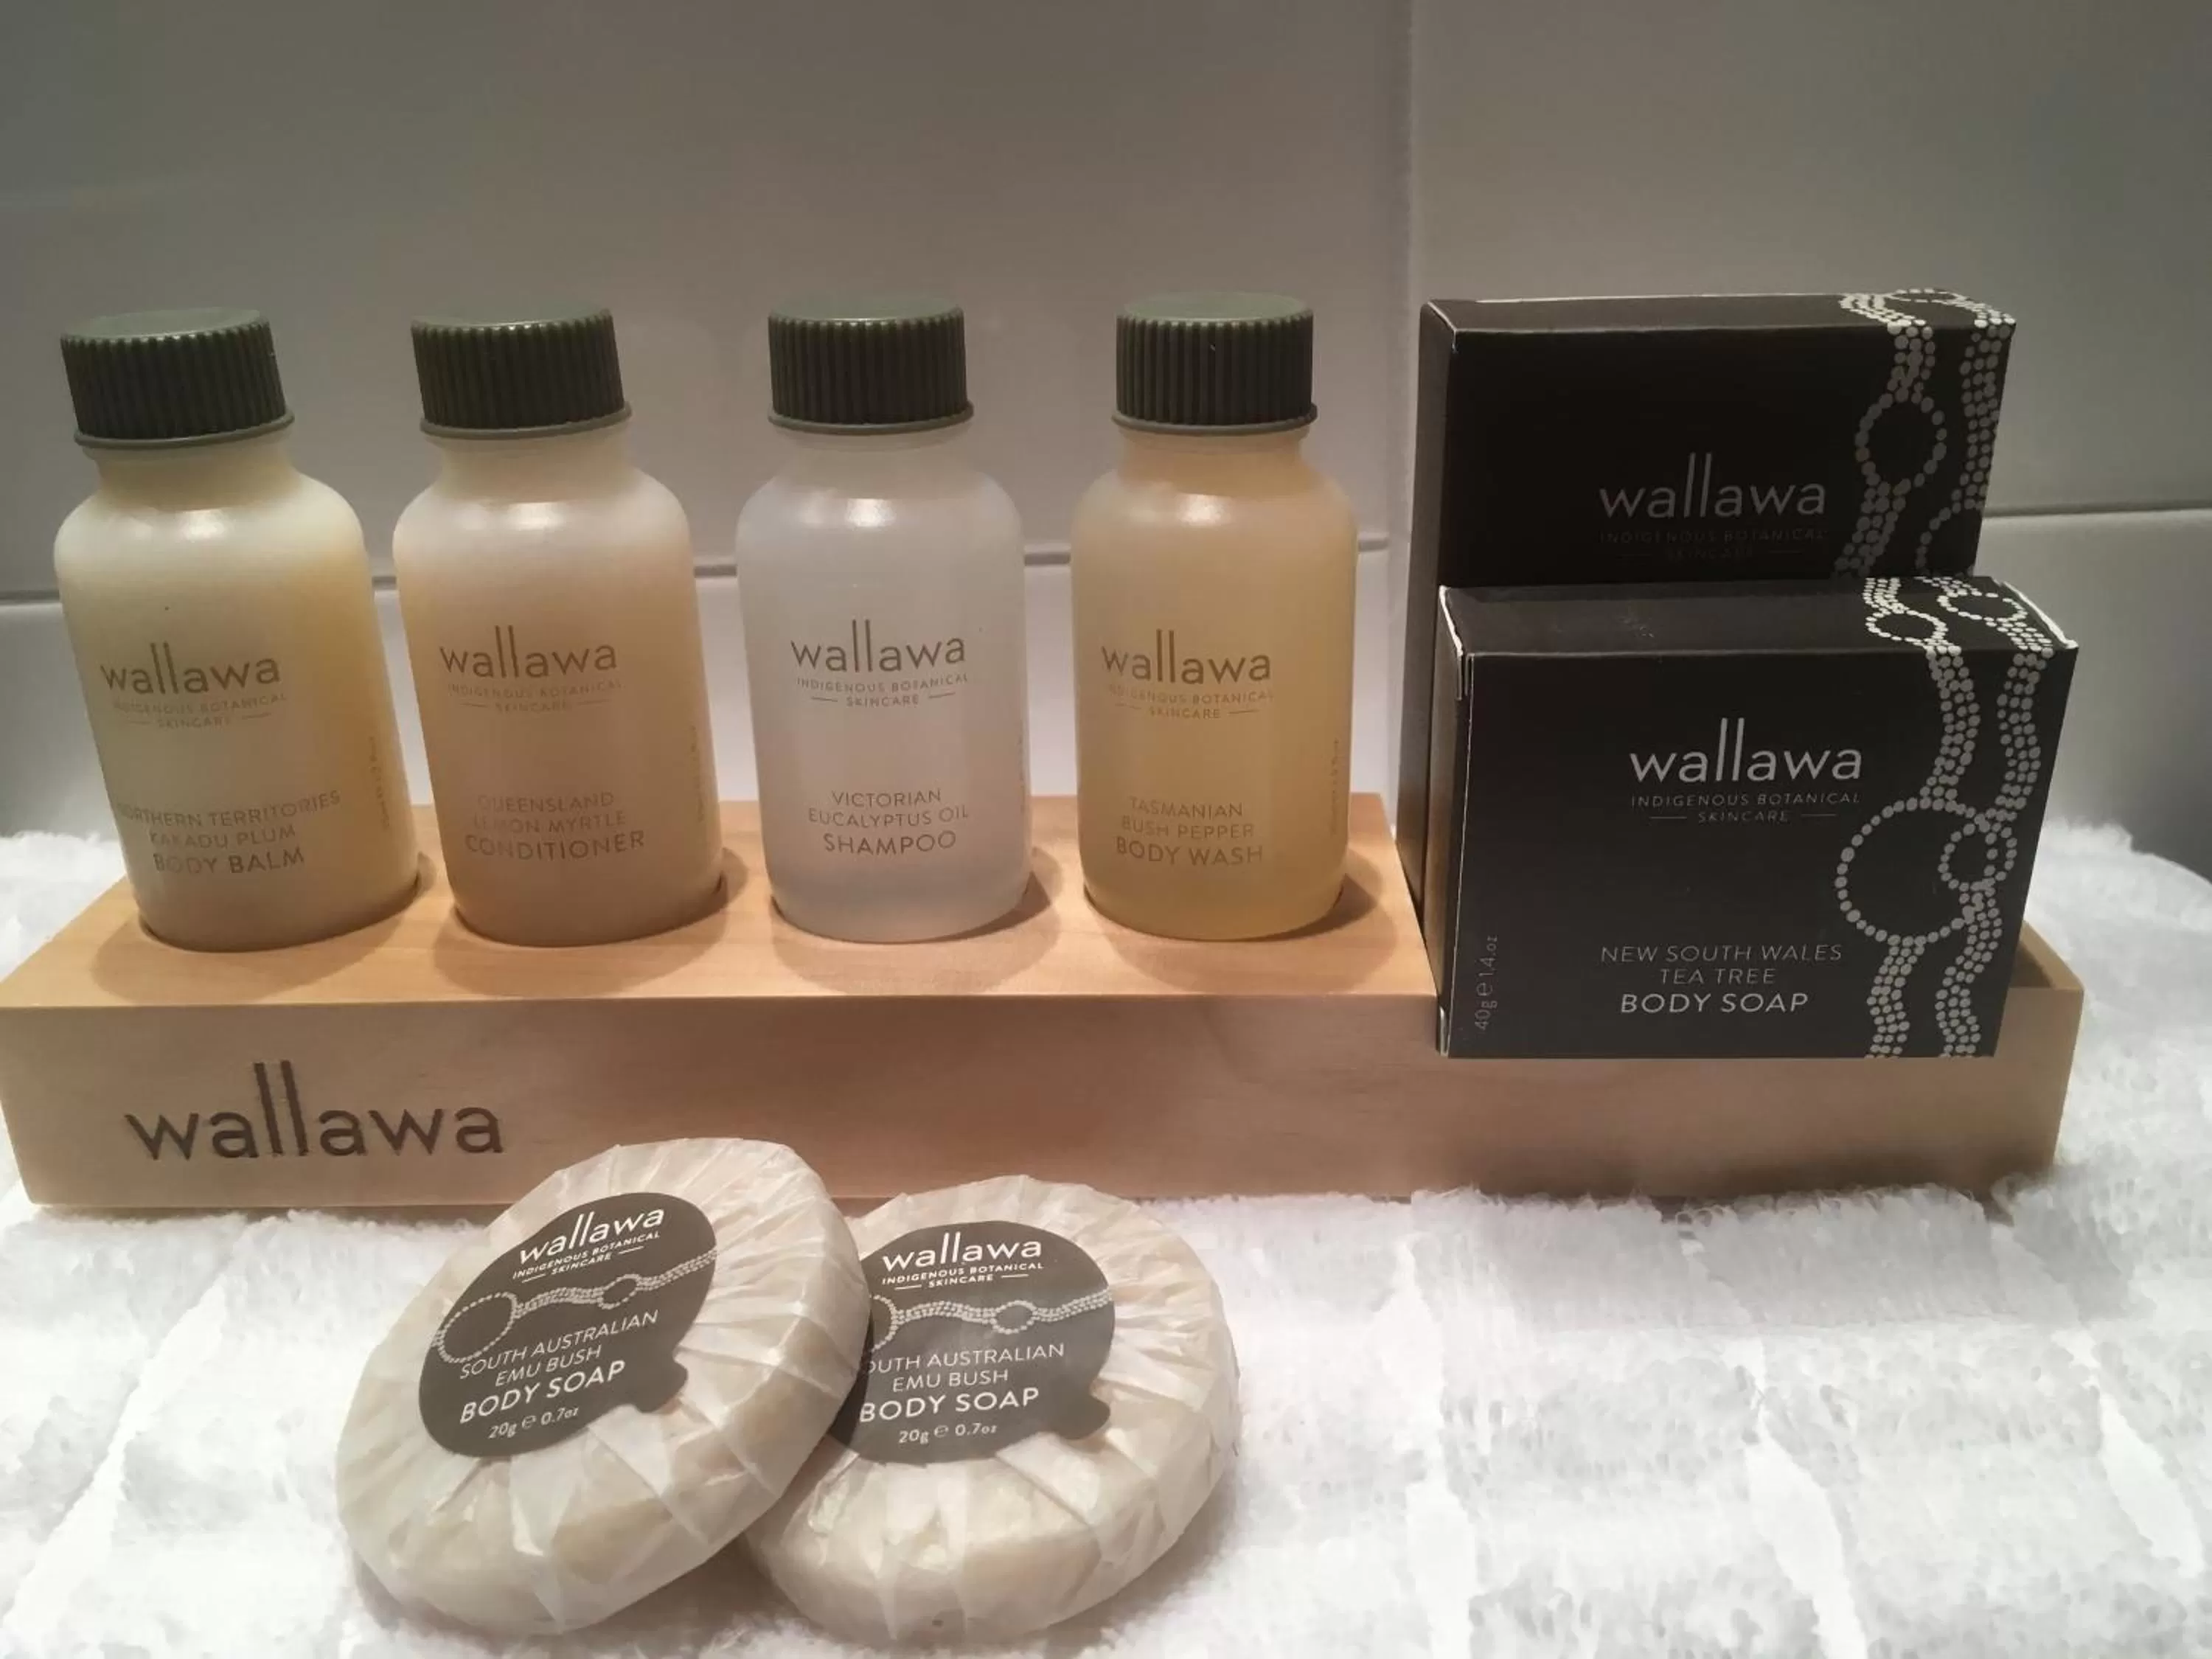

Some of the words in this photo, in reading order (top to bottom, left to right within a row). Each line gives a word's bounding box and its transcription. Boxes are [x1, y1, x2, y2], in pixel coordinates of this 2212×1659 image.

[1599, 452, 1826, 518] wallawa
[439, 625, 618, 678] wallawa
[790, 619, 966, 673] wallawa
[1101, 628, 1271, 684] wallawa
[100, 641, 281, 695] wallawa
[796, 676, 886, 693] INDIGENOUS
[891, 673, 968, 692] BOTANICAL
[845, 695, 919, 707] SKINCARE
[1630, 717, 1863, 783] wallawa
[209, 790, 341, 827] TERRITORIES
[477, 791, 615, 813] QUEENSLAND
[831, 787, 942, 808] VICTORIAN
[1129, 795, 1243, 819] TASMANIAN
[1631, 793, 1750, 809] INDIGENOUS
[1756, 791, 1861, 805] BOTANICAL
[549, 811, 627, 833] MYRTLE
[807, 807, 932, 828] EUCALYPTUS
[939, 804, 969, 823] OIL
[1121, 815, 1169, 838] BUSH
[1177, 823, 1255, 840] PEPPER
[1698, 811, 1789, 824] SKINCARE
[149, 832, 229, 849] KAKADU
[237, 824, 296, 846] PLUM
[465, 830, 645, 860] CONDITIONER
[823, 830, 956, 855] SHAMPOO
[153, 852, 218, 874] BODY
[228, 846, 305, 874] BALM
[1116, 835, 1180, 865] BODY
[1188, 845, 1264, 867] WASH
[1601, 946, 1658, 963] NEW
[1666, 945, 1752, 962] SOUTH
[1761, 944, 1842, 961] WALES
[1660, 968, 1705, 984] TEA
[1714, 967, 1777, 984] TREE
[1475, 1000, 1498, 1031] 40g
[1621, 992, 1712, 1013] BODY
[1721, 992, 1809, 1013] SOAP
[125, 1060, 504, 1160] wallawa
[518, 1208, 665, 1265] wallawa
[512, 1249, 588, 1280] INDIGENOUS
[591, 1231, 661, 1256] BOTANICAL
[551, 1253, 611, 1276] SKINCARE
[882, 1231, 1043, 1273] wallawa
[881, 1267, 964, 1285] INDIGENOUS
[969, 1262, 1045, 1276] BOTANICAL
[928, 1273, 994, 1289] SKINCARE
[459, 1347, 527, 1380] SOUTH
[530, 1309, 660, 1358] AUSTRALIAN
[869, 1354, 921, 1374] UTH
[926, 1342, 1065, 1368] AUSTRALIAN
[495, 1365, 540, 1388] EMU
[546, 1343, 603, 1374] BUSH
[459, 1382, 540, 1425] BODY
[546, 1360, 626, 1399] SOAP
[892, 1372, 941, 1393] EMU
[948, 1368, 1009, 1388] BUSH
[859, 1394, 947, 1423] BODY
[955, 1387, 1040, 1413] SOAP
[487, 1421, 518, 1439] 20g
[540, 1407, 580, 1426] 0.7oz
[897, 1429, 929, 1444] 20g
[954, 1422, 998, 1437] 0.7oz
